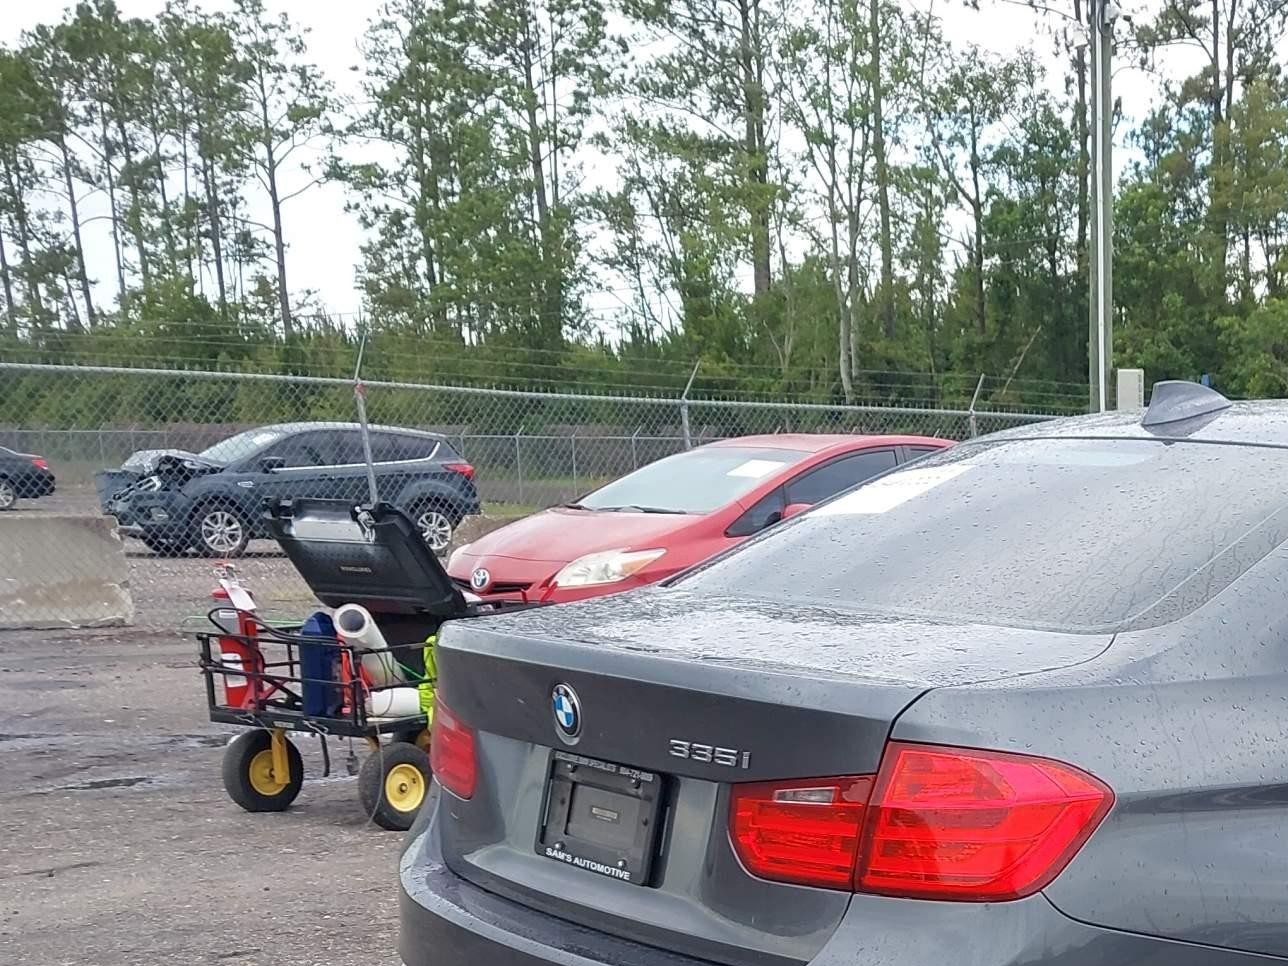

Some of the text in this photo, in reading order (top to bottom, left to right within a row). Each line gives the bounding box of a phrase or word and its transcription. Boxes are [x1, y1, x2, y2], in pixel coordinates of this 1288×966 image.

[669, 739, 750, 769] 335i
[546, 847, 631, 881] SAM'S AUTOMOTIVE
